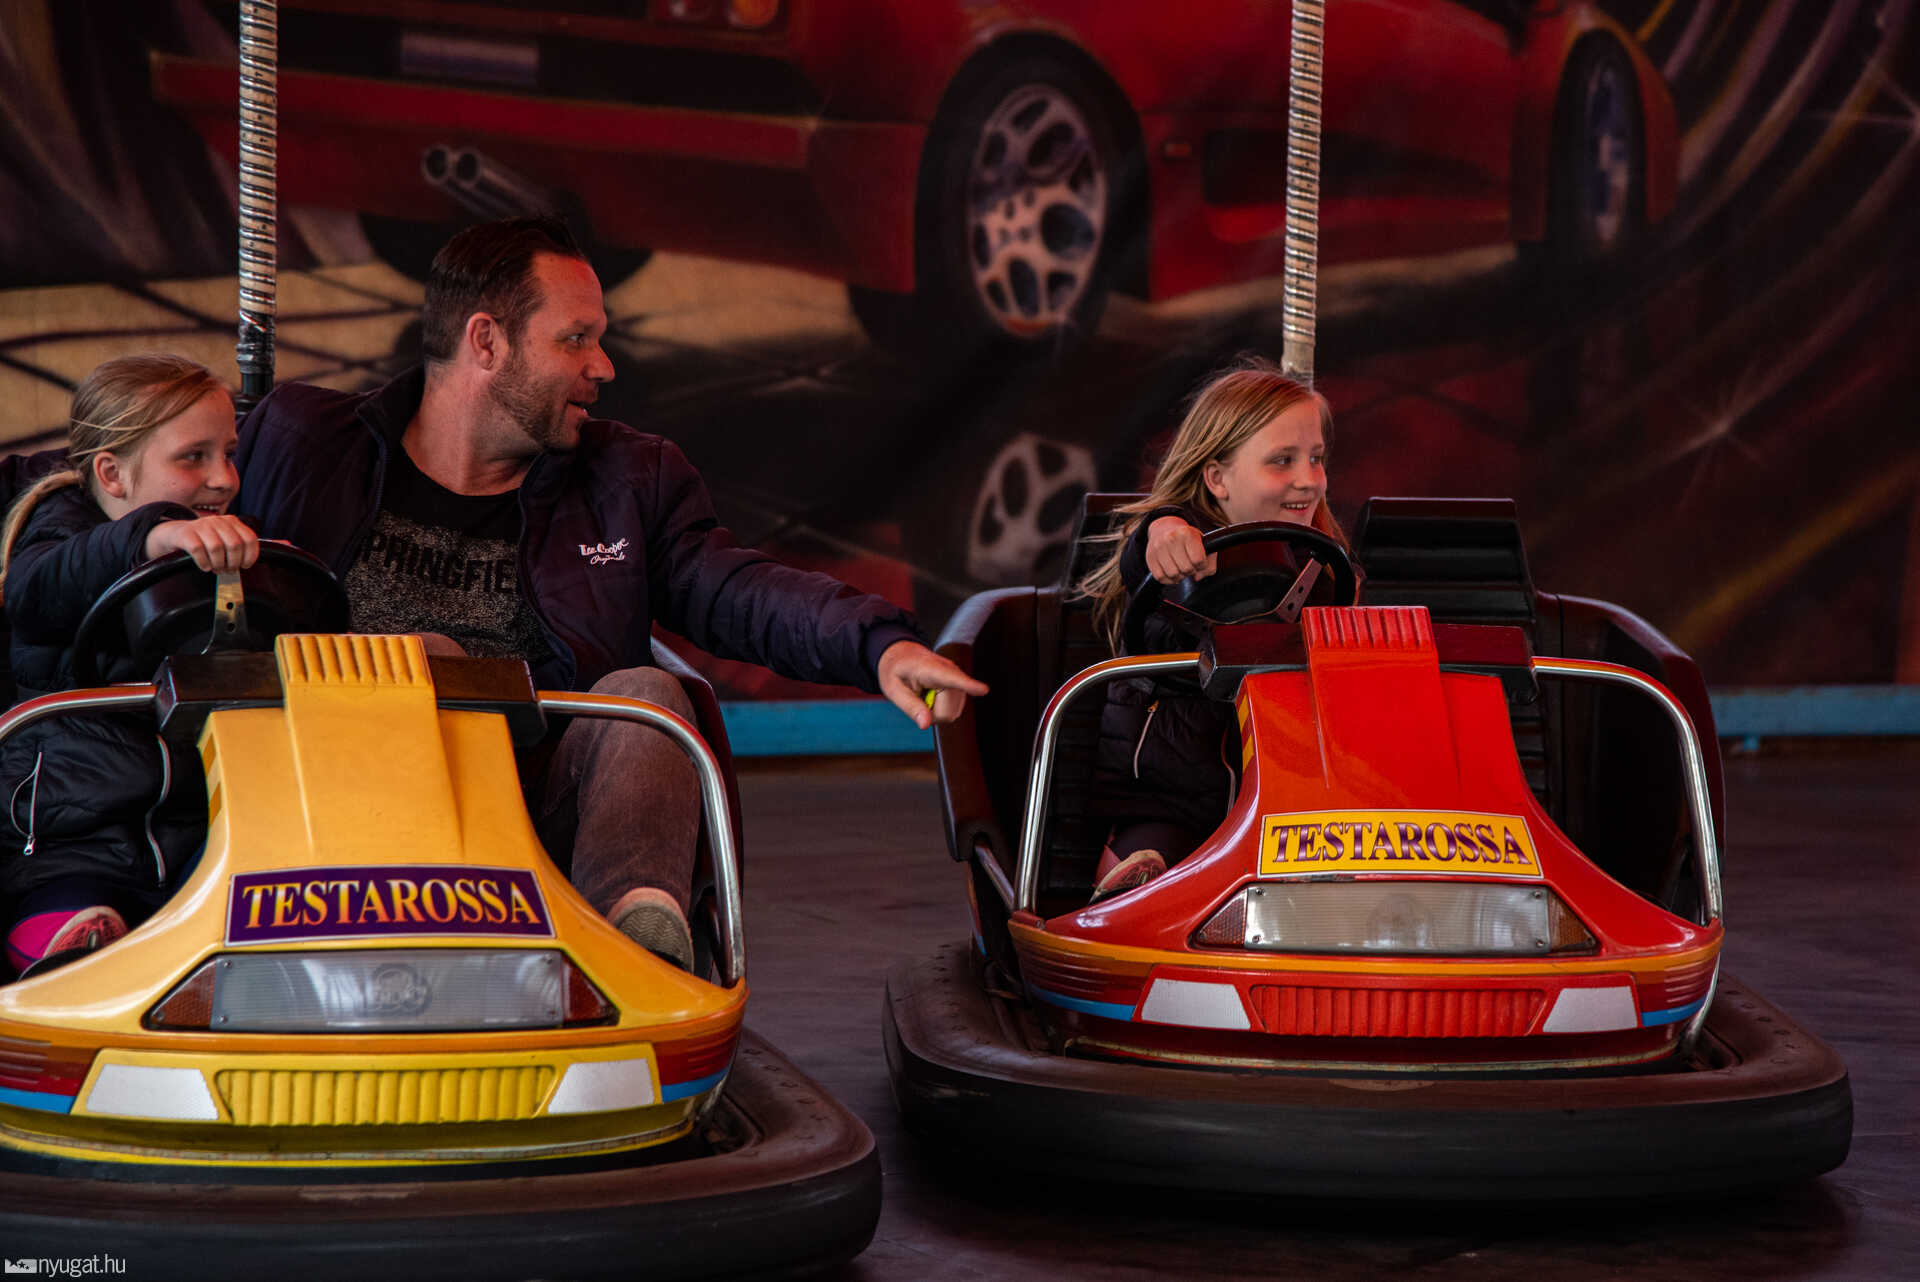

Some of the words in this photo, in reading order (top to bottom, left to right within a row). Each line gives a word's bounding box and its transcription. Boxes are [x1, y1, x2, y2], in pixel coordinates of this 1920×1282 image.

[356, 531, 520, 592] PRINGFIE
[579, 544, 597, 556] Lee
[1271, 821, 1532, 865] TESTAROSSA
[242, 878, 541, 929] TESTAROSSA
